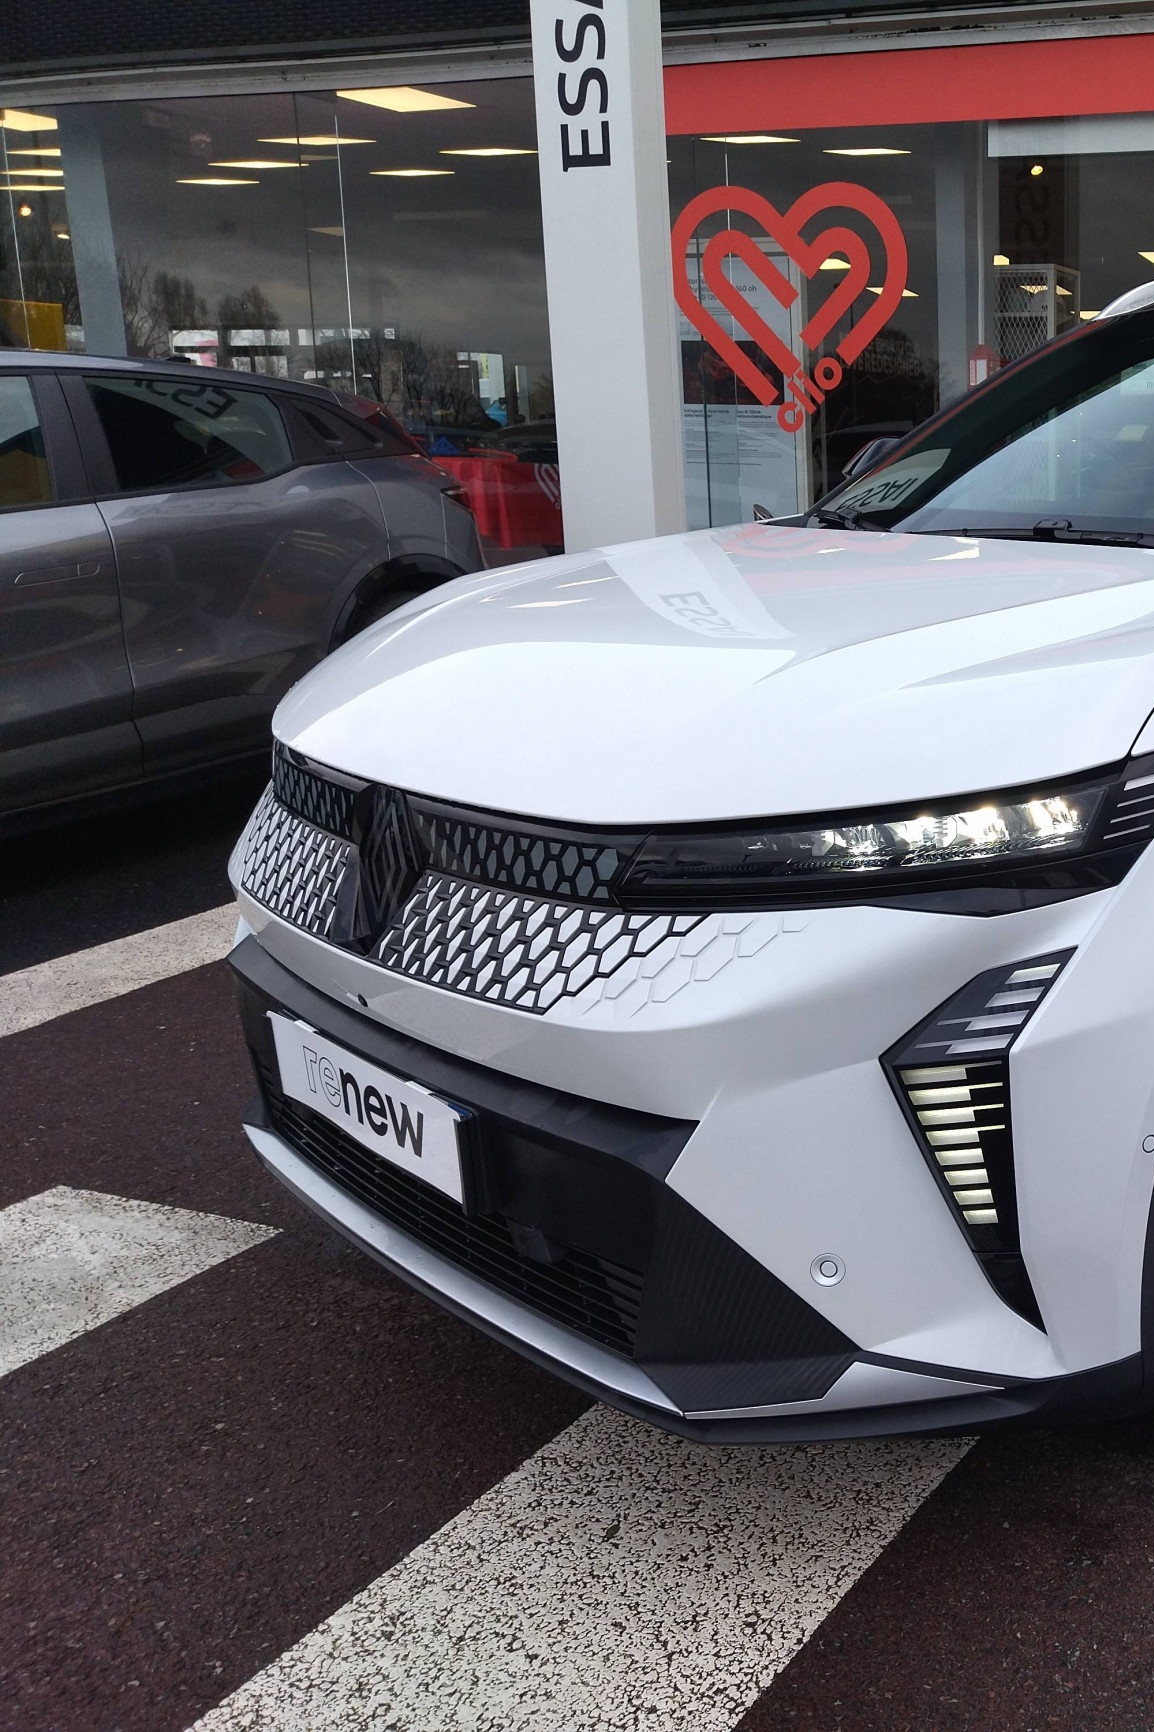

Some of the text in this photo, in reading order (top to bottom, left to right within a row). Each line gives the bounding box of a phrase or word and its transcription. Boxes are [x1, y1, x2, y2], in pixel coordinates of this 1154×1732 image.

[555, 0, 611, 172] ESS
[748, 284, 757, 292] ch
[777, 357, 843, 433] clio
[302, 1045, 424, 1158] renew
